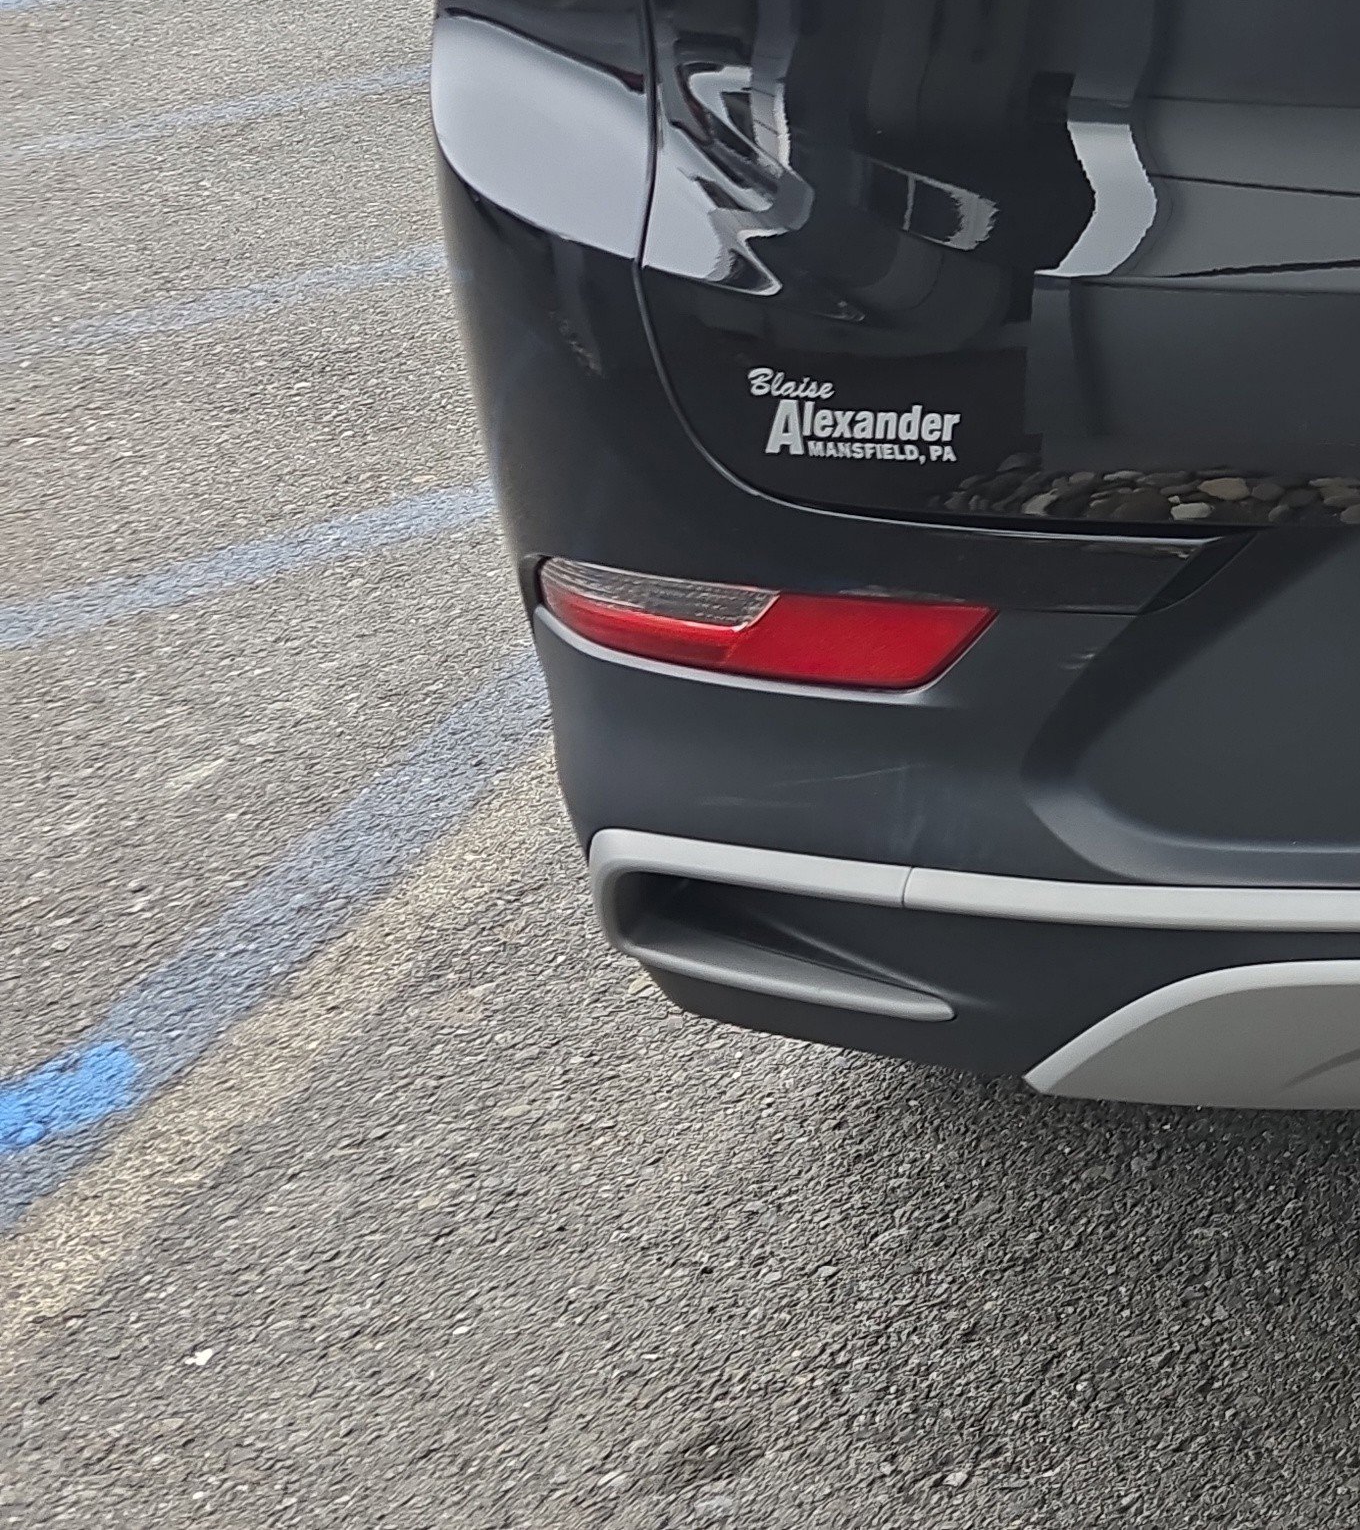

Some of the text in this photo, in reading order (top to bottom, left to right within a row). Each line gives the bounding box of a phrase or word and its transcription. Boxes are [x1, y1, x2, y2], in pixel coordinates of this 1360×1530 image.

[747, 366, 836, 400] Blaise
[764, 398, 961, 456] Alexander
[807, 440, 957, 465] MANSFIELD, PA
